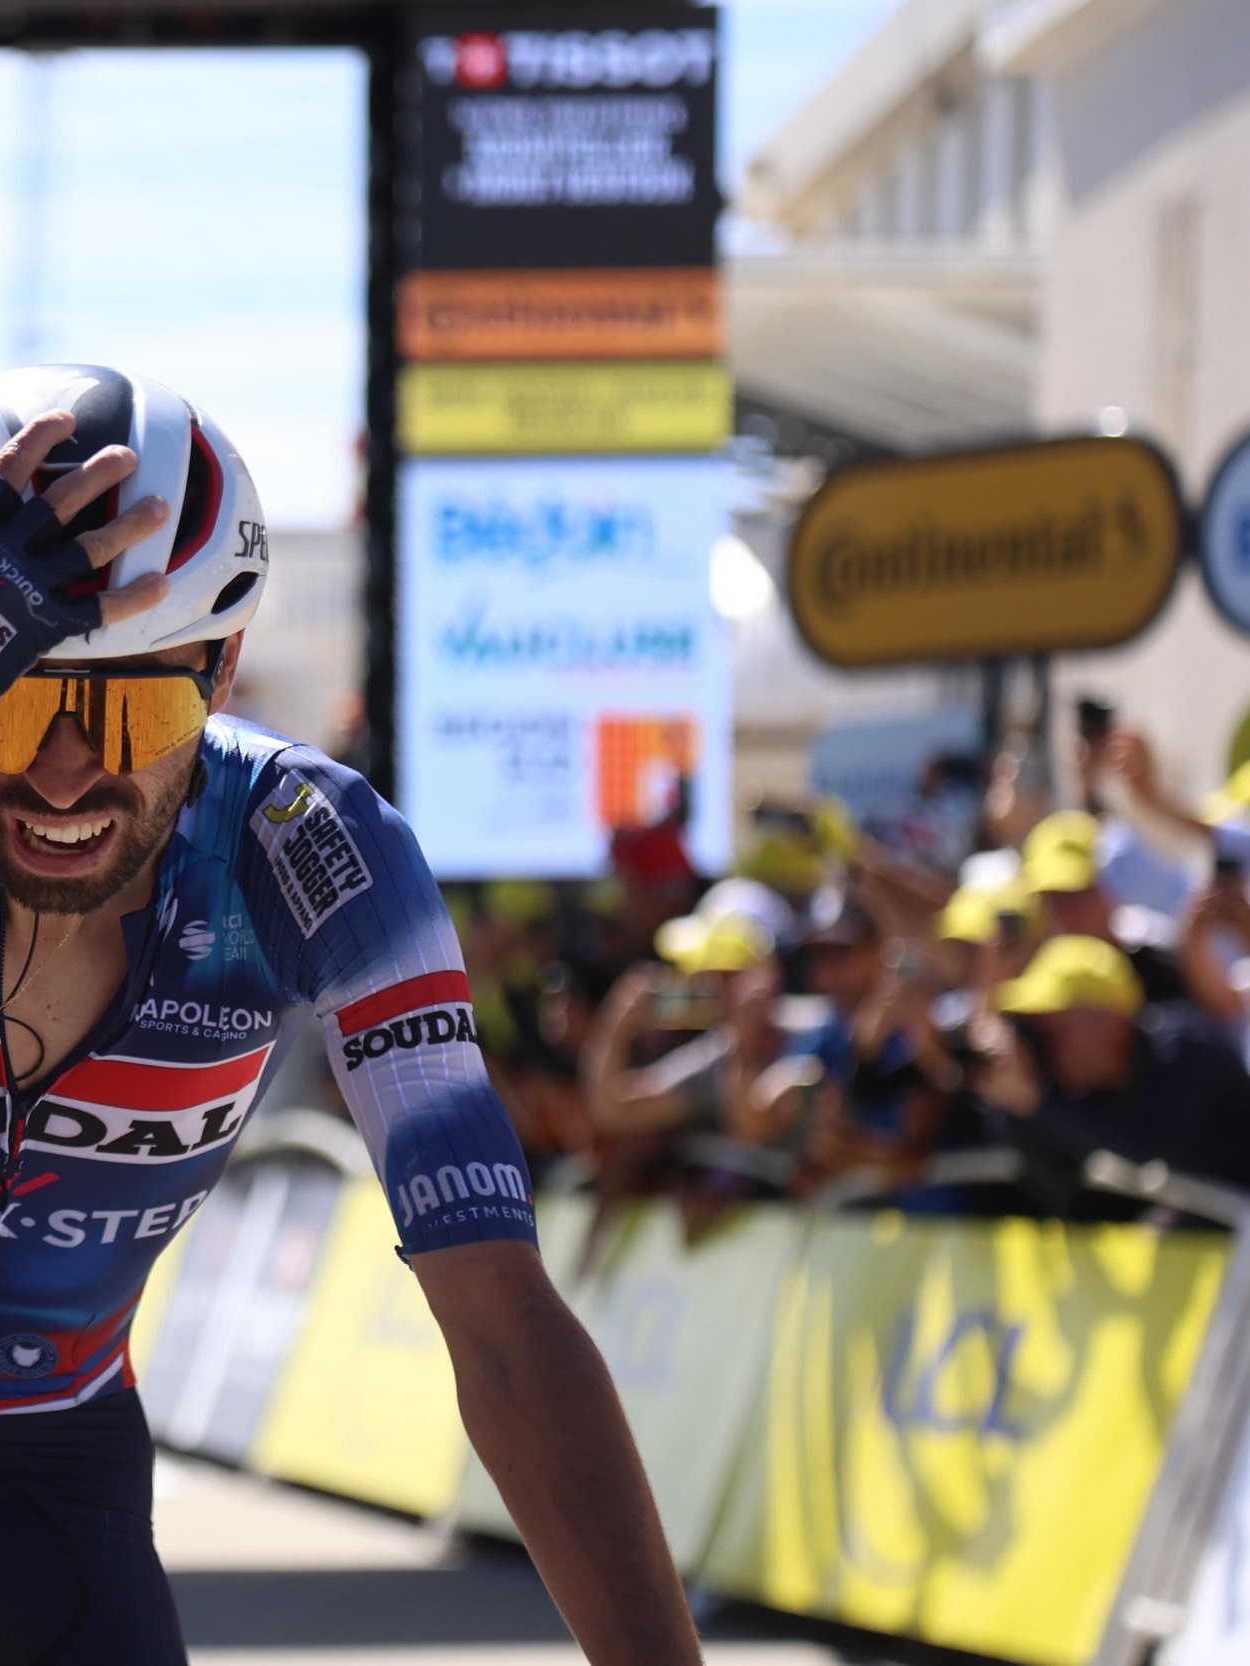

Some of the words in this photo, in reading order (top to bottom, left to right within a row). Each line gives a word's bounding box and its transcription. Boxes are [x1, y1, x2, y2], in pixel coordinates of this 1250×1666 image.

[234, 520, 269, 563] SPE
[812, 494, 1105, 620] Continental
[283, 823, 340, 918] JOGGER
[304, 806, 367, 893] SAFETY
[140, 1019, 189, 1035] SPORTS
[192, 1027, 201, 1036] &
[203, 1028, 247, 1042] CASINO
[343, 1008, 478, 1073] SOUDA
